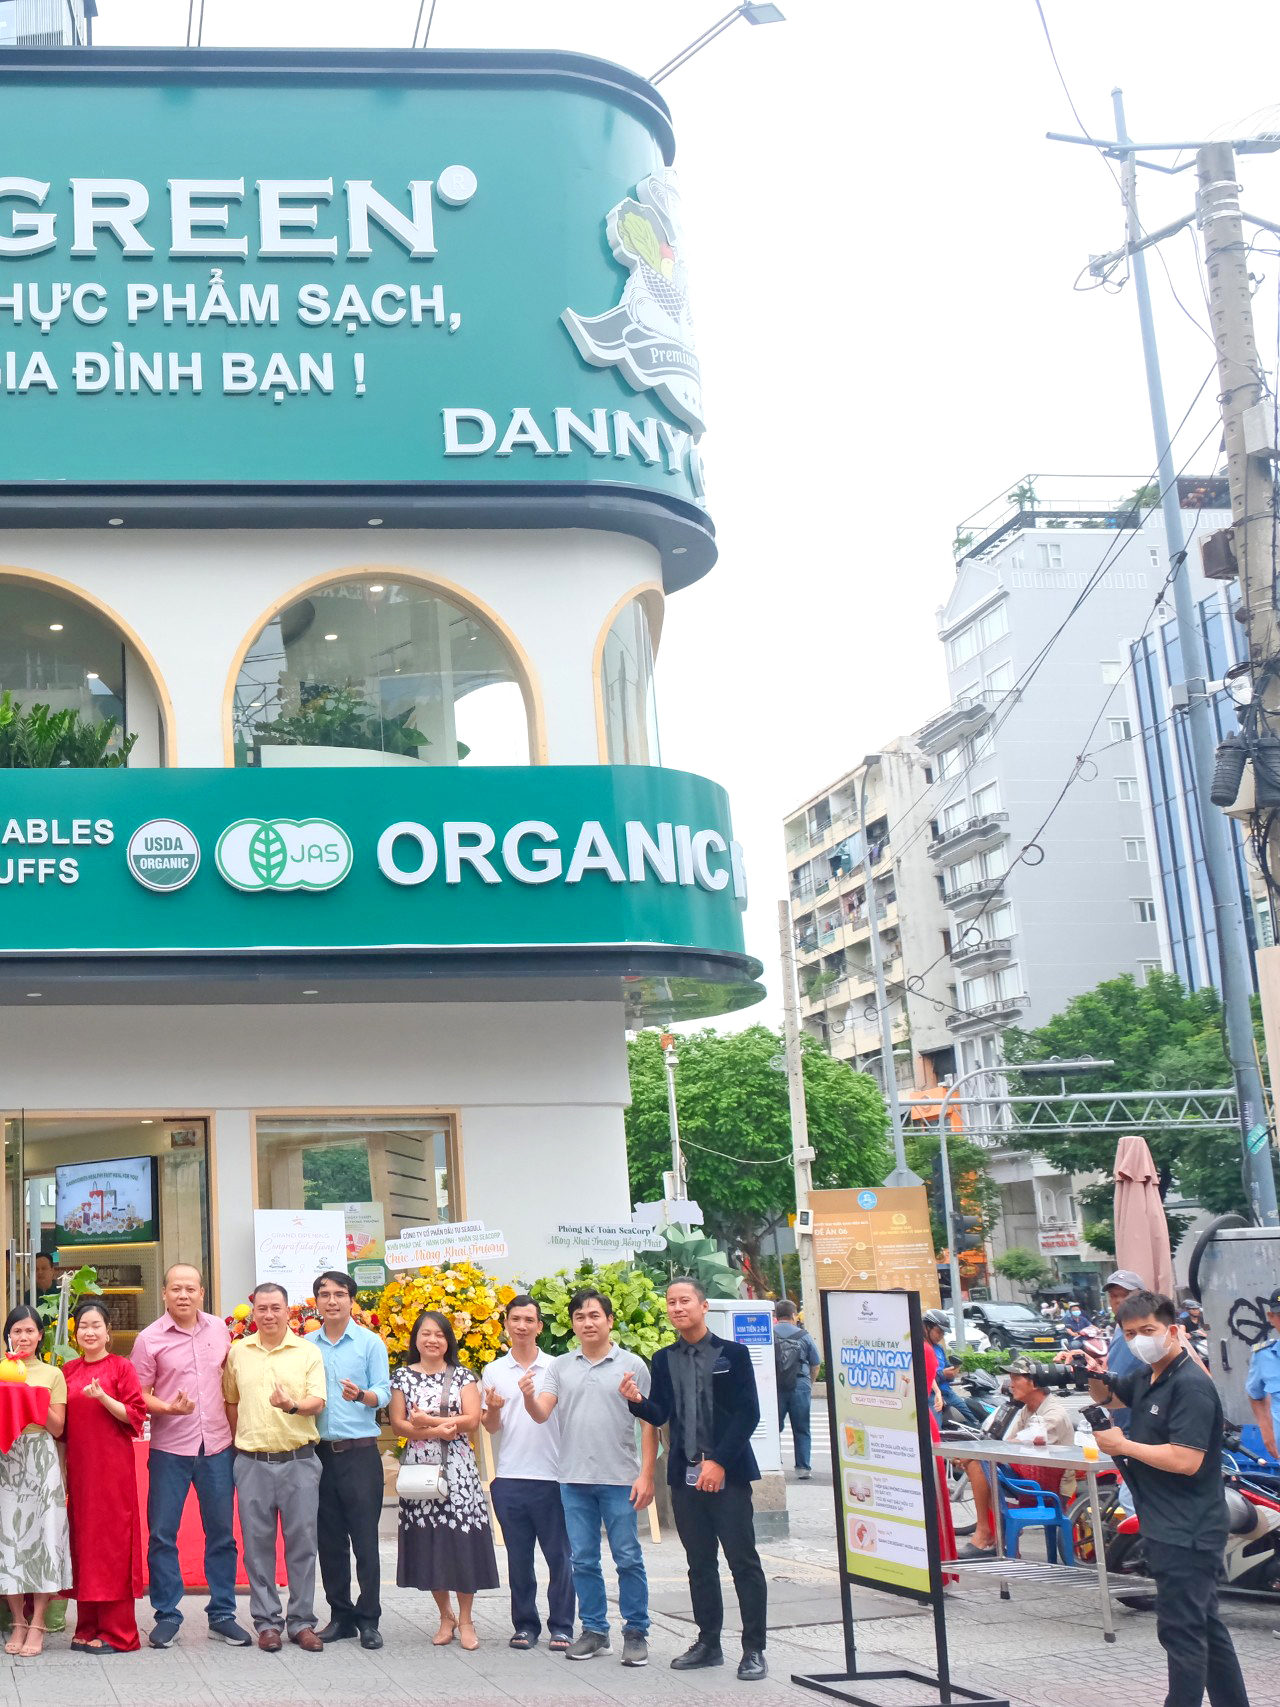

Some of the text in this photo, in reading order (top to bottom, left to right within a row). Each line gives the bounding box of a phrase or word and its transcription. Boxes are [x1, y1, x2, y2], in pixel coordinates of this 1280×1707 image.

[127, 268, 280, 325] PHẨM
[297, 283, 462, 334] SẠCH,
[72, 341, 203, 394] ĐÌNH
[222, 352, 334, 403] BẠN
[441, 407, 693, 474] DANNY
[144, 837, 183, 851] USDA
[290, 844, 340, 863] JAS
[139, 857, 189, 870] ORGANIC
[376, 820, 730, 892] ORGANIC
[618, 1226, 651, 1236] SeaCorp
[887, 1341, 899, 1349] TAY
[841, 1347, 912, 1369] NHẬN NGAY
[848, 1367, 896, 1390] ƯU ĐÃI
